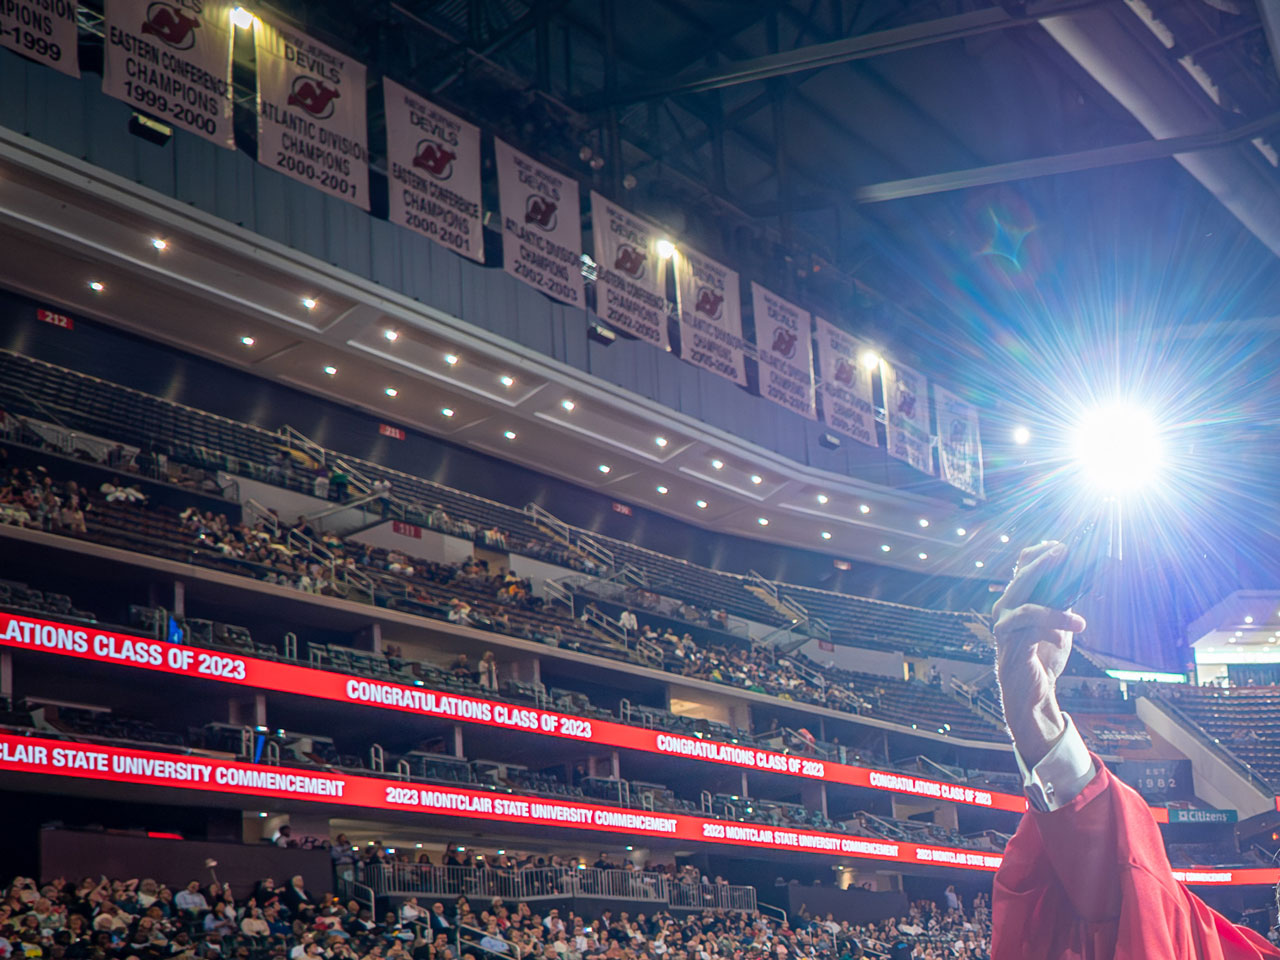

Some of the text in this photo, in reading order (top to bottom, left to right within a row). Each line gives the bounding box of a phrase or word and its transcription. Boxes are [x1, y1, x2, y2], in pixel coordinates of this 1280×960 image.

[0, 21, 61, 61] -1999
[110, 25, 159, 65] EASTERN
[285, 43, 341, 85] DEVILS
[124, 80, 217, 135] 1999-2000
[126, 57, 218, 116] CHAMPIONS
[261, 97, 315, 140] ATLANTIC
[410, 110, 459, 146] DEVILS
[277, 151, 357, 198] 2000-2001
[281, 133, 351, 177] CHAMPIONS
[403, 189, 470, 235] CHAMPIONS
[405, 210, 471, 251] 2000-2001
[44, 311, 69, 327] 212
[0, 619, 246, 680] ATIONS CLASS OF 2023
[346, 679, 592, 739] CONGRATULATIONS CLASS OF 2023
[0, 742, 345, 797] LAIR STATE UNIVERSITY COMMENCEMENT
[656, 734, 825, 778] CONGRATULATIONS CLASS OF 2023
[385, 786, 678, 833] 2023 MONTCLAIR STATE UNIVERSITY COMMENCEMENT
[869, 771, 993, 806] CONGRATULATIONS CLASS OF 2023
[702, 823, 899, 857] 2023 MONTCLAIR STATE UNIVERSITY COMMENCEMENT
